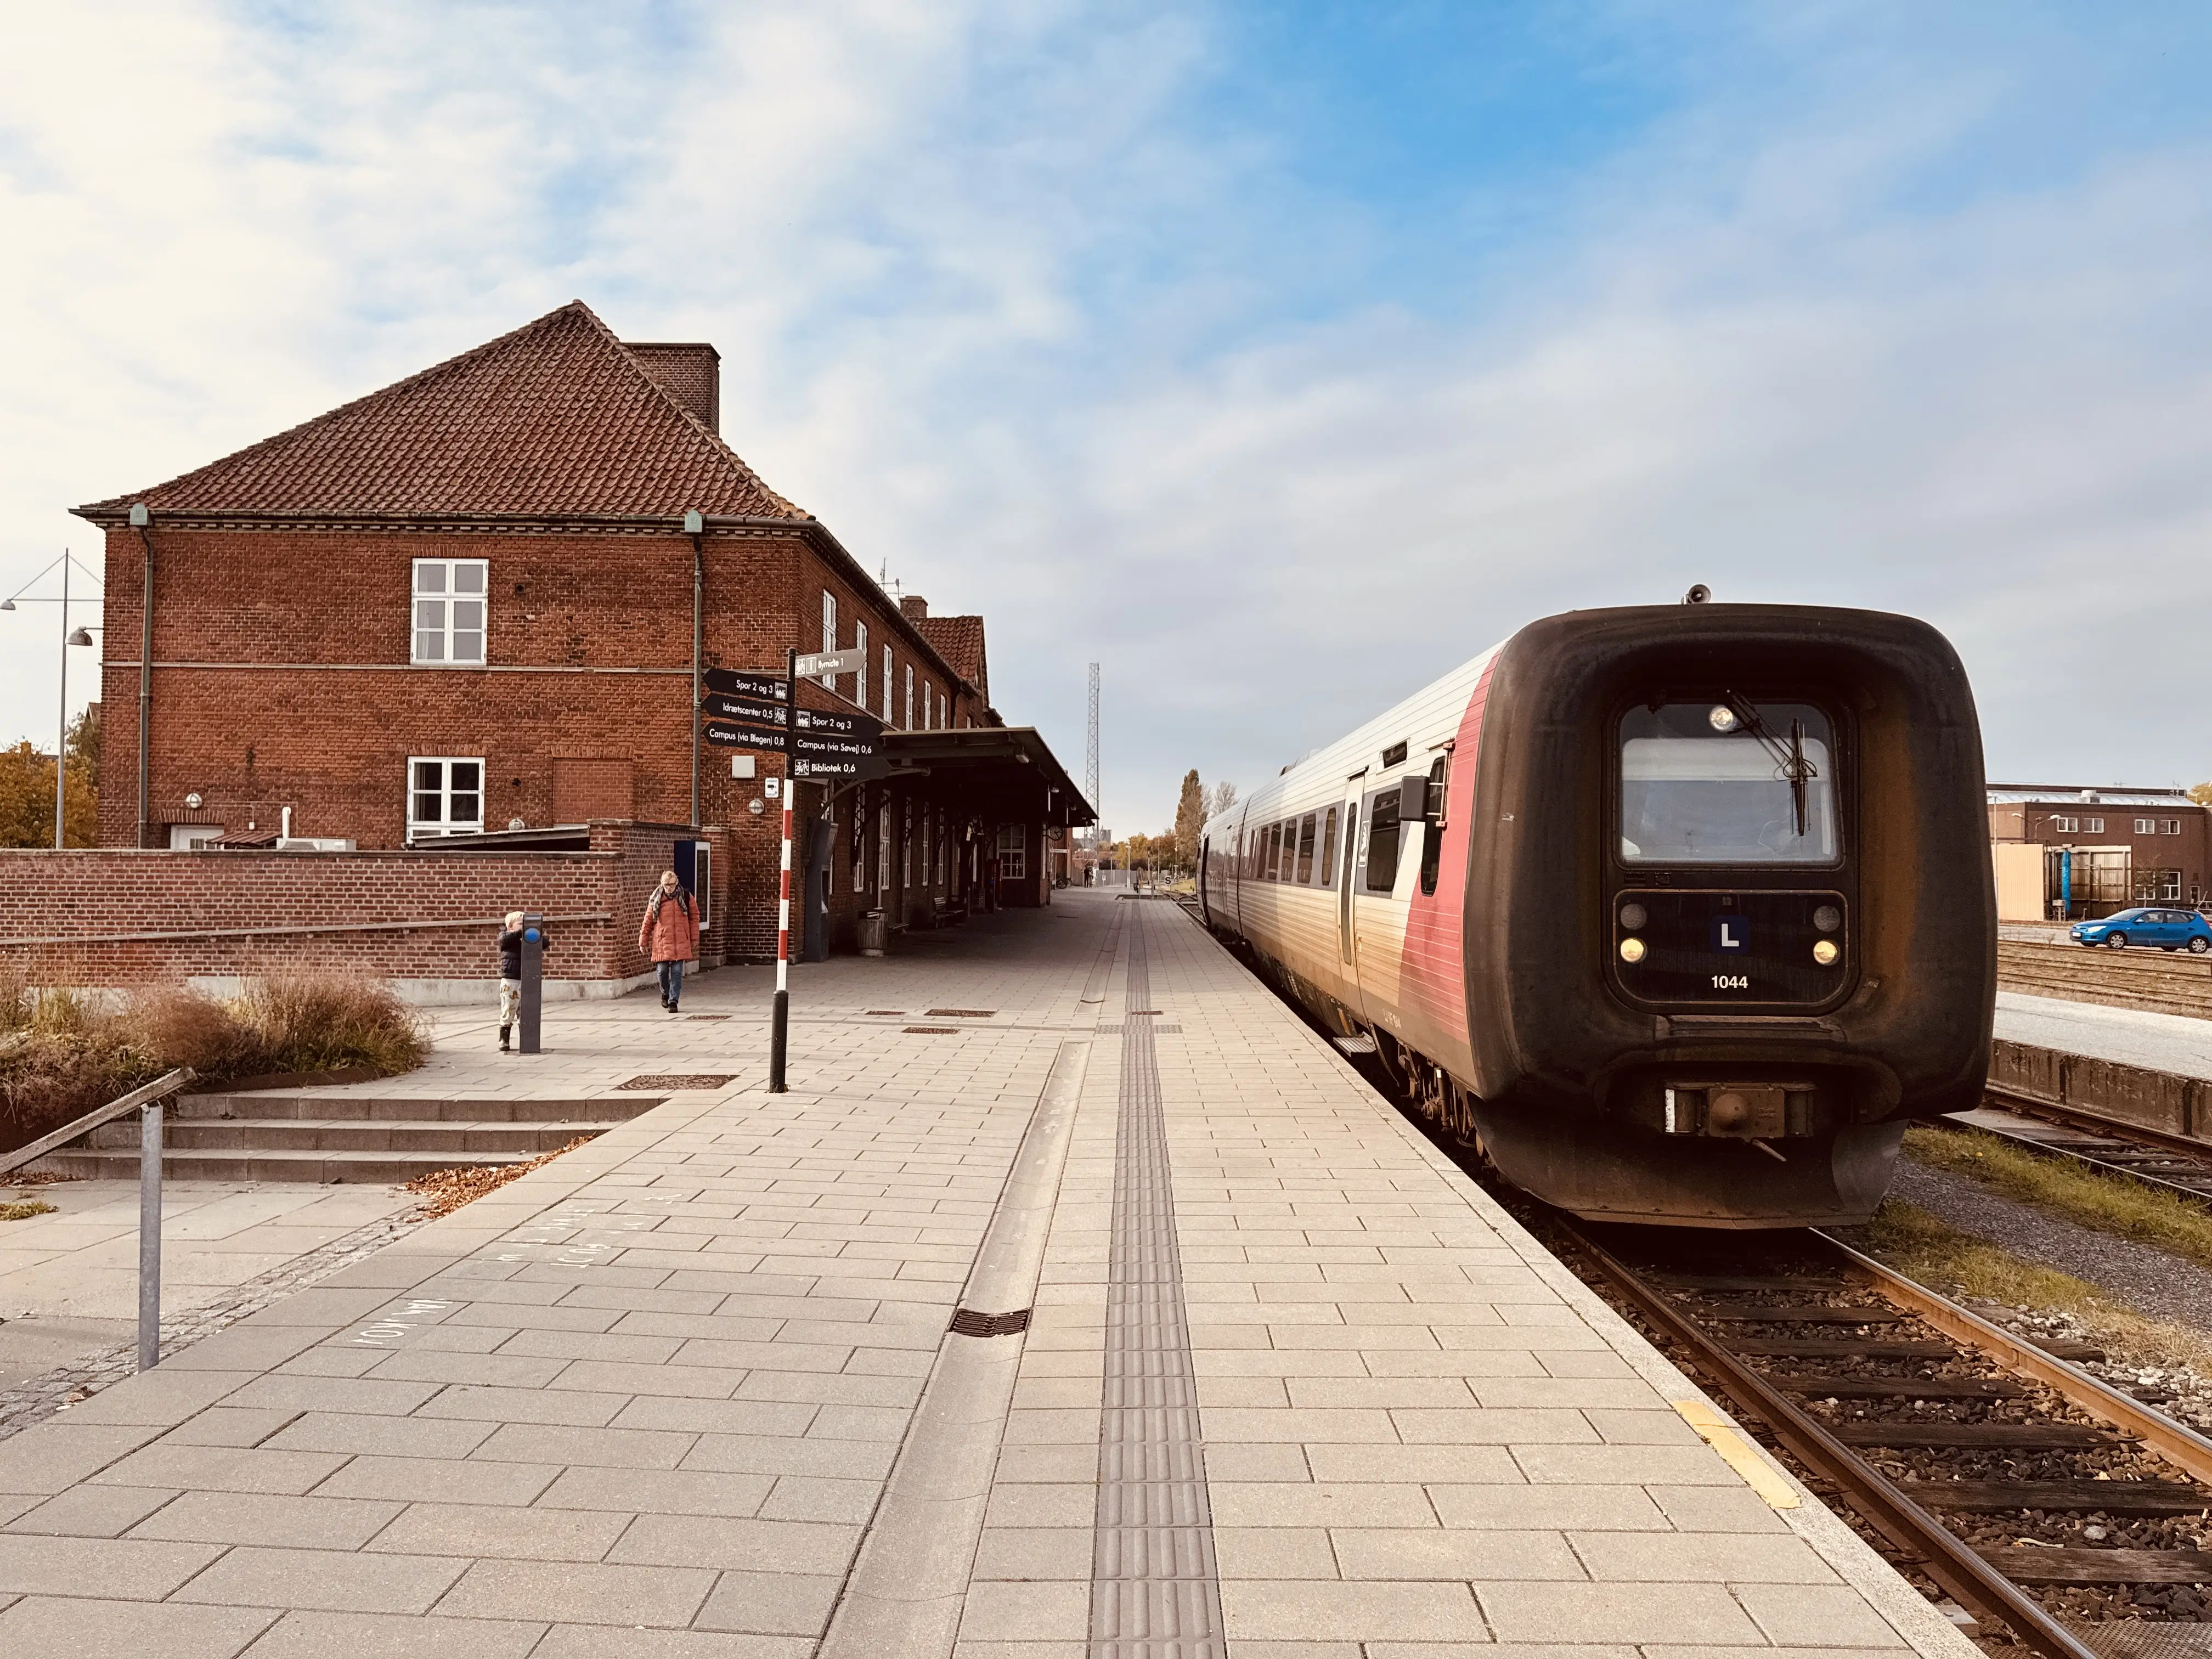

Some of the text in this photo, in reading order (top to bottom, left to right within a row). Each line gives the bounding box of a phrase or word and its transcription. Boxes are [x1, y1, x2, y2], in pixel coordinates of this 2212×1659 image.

[818, 657, 844, 670] Bymidte 1
[736, 679, 773, 695] Spor 2 og 3
[723, 702, 773, 719] Idrætscenter 0,5
[812, 716, 851, 730] Spor 2 og 3
[709, 728, 785, 747] Campus (via Blegen) 0,8
[797, 739, 872, 755] Campus (via Søvej) 0,6
[811, 763, 856, 774] Bibliotek 0,6
[1721, 923, 1740, 947] L
[1711, 975, 1748, 989] 1044
